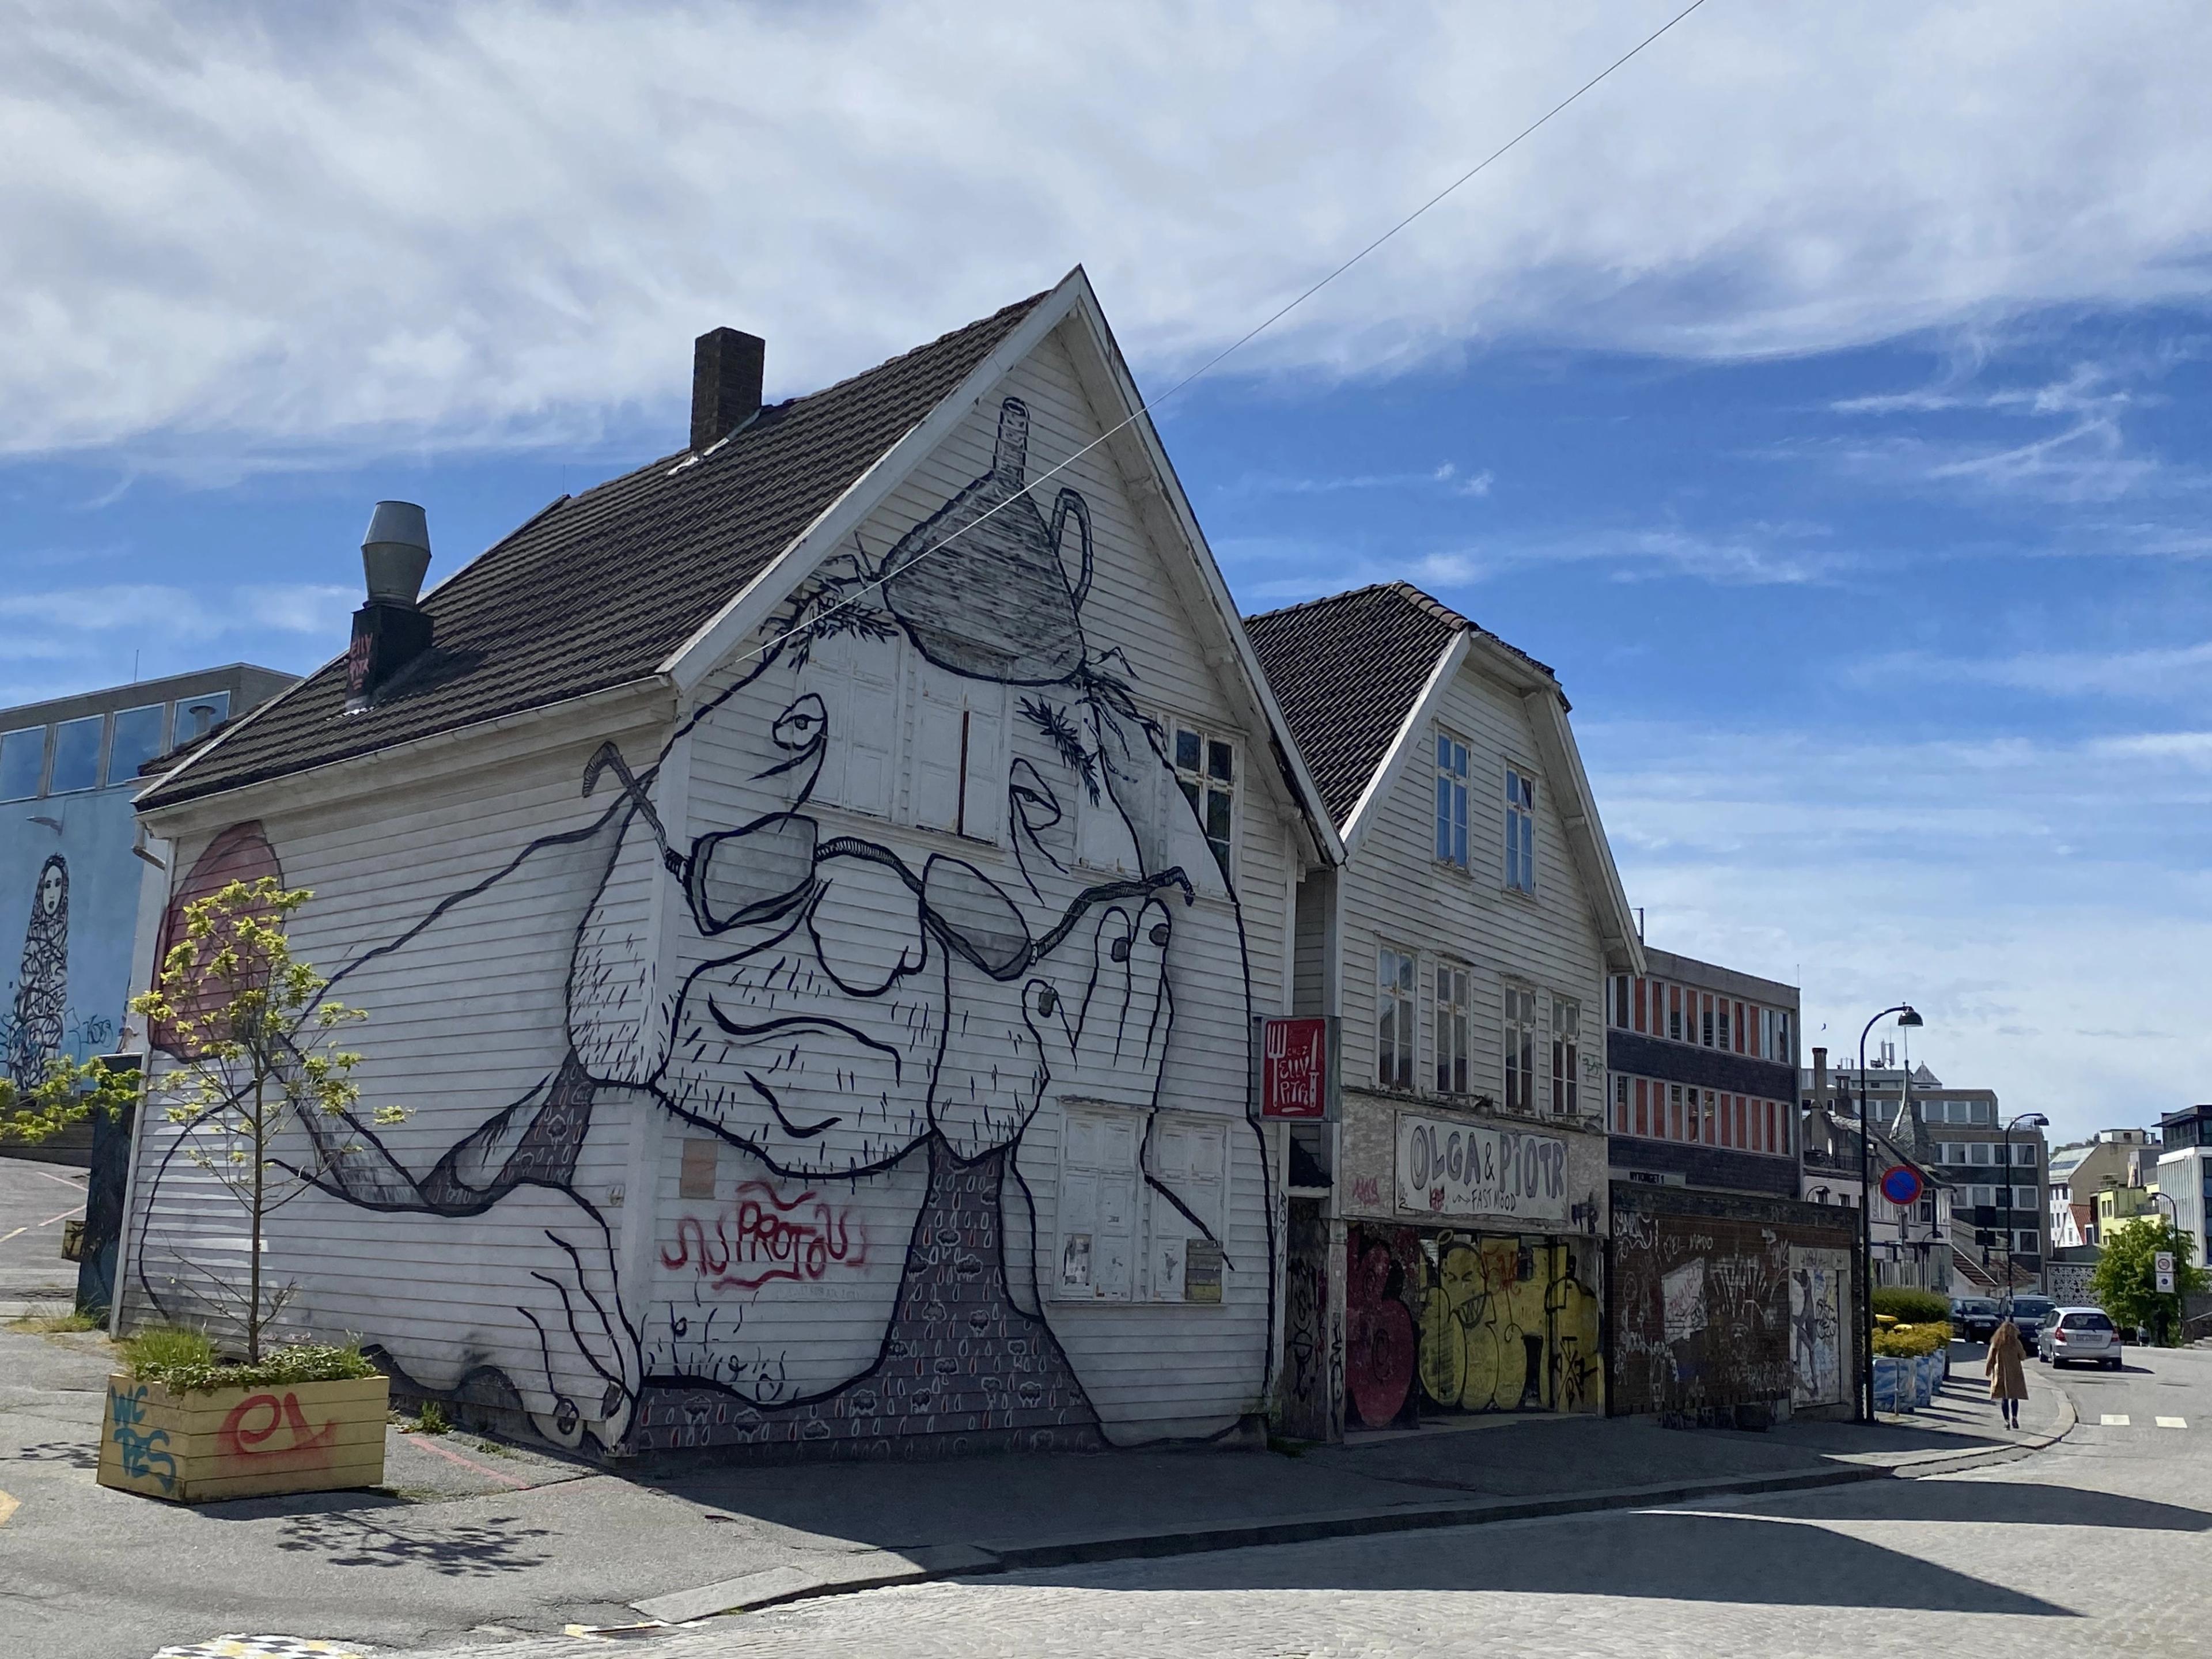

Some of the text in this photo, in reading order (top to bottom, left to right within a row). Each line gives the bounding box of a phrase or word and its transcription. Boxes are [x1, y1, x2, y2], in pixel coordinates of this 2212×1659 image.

[1410, 1124, 1481, 1191] OLGA
[1484, 1141, 1495, 1181] &
[1471, 1188, 1492, 1211] FAST
[1493, 1190, 1516, 1212] MOOD
